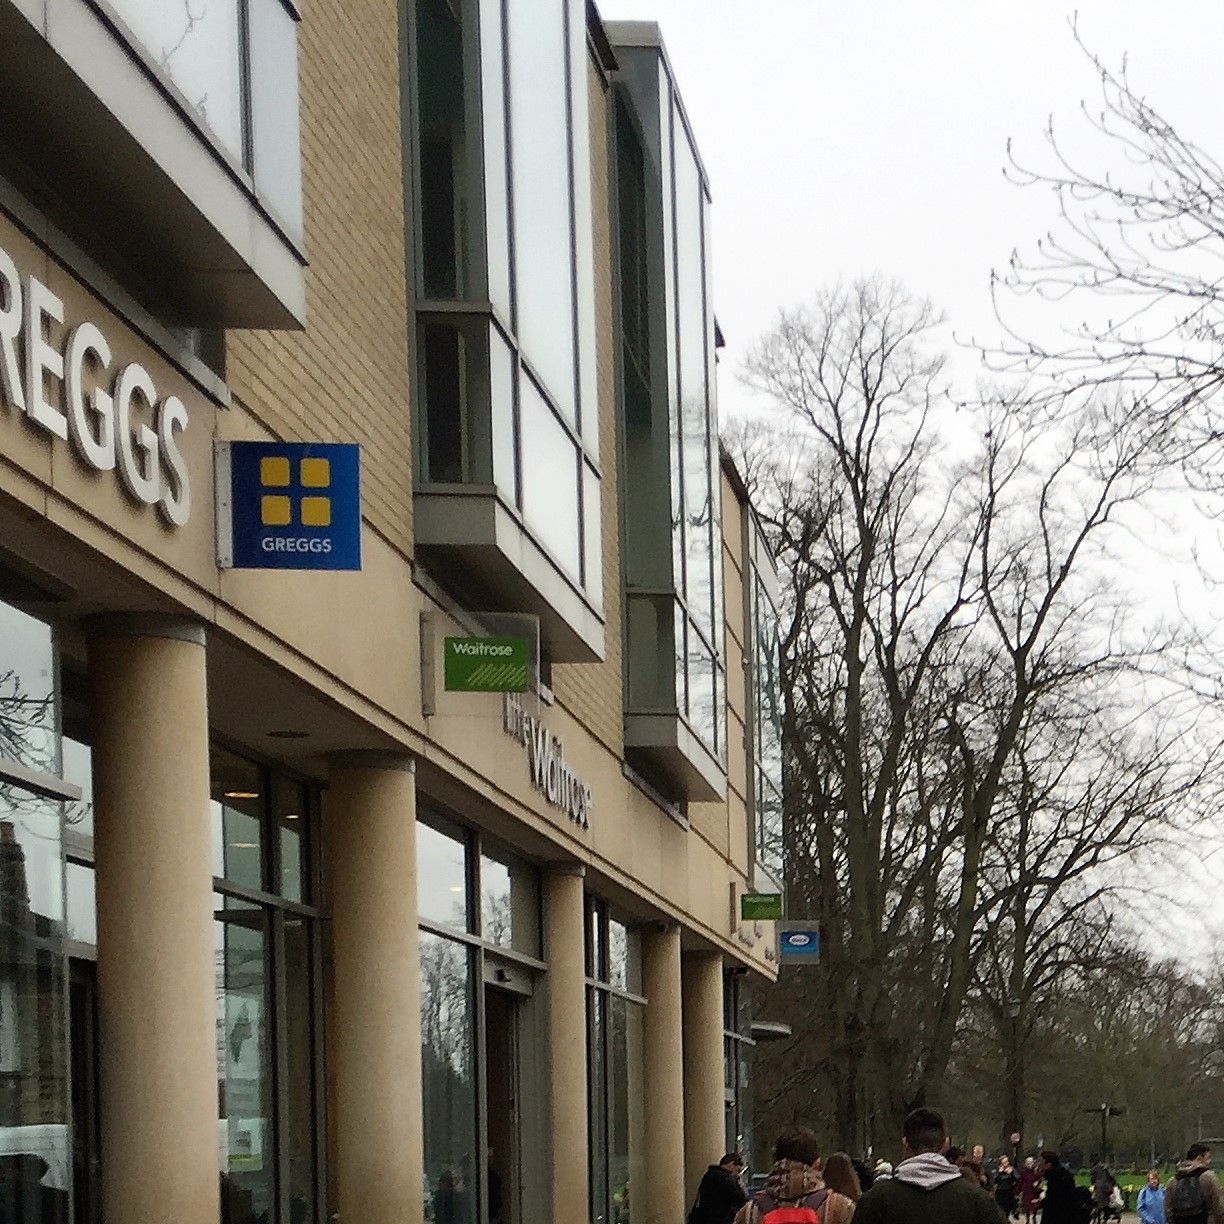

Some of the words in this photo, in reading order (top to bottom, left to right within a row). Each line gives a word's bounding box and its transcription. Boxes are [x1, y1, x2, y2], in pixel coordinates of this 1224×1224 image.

[262, 537, 332, 553] GREGGS
[453, 642, 514, 657] Waitrose
[530, 716, 593, 828] Waitrose
